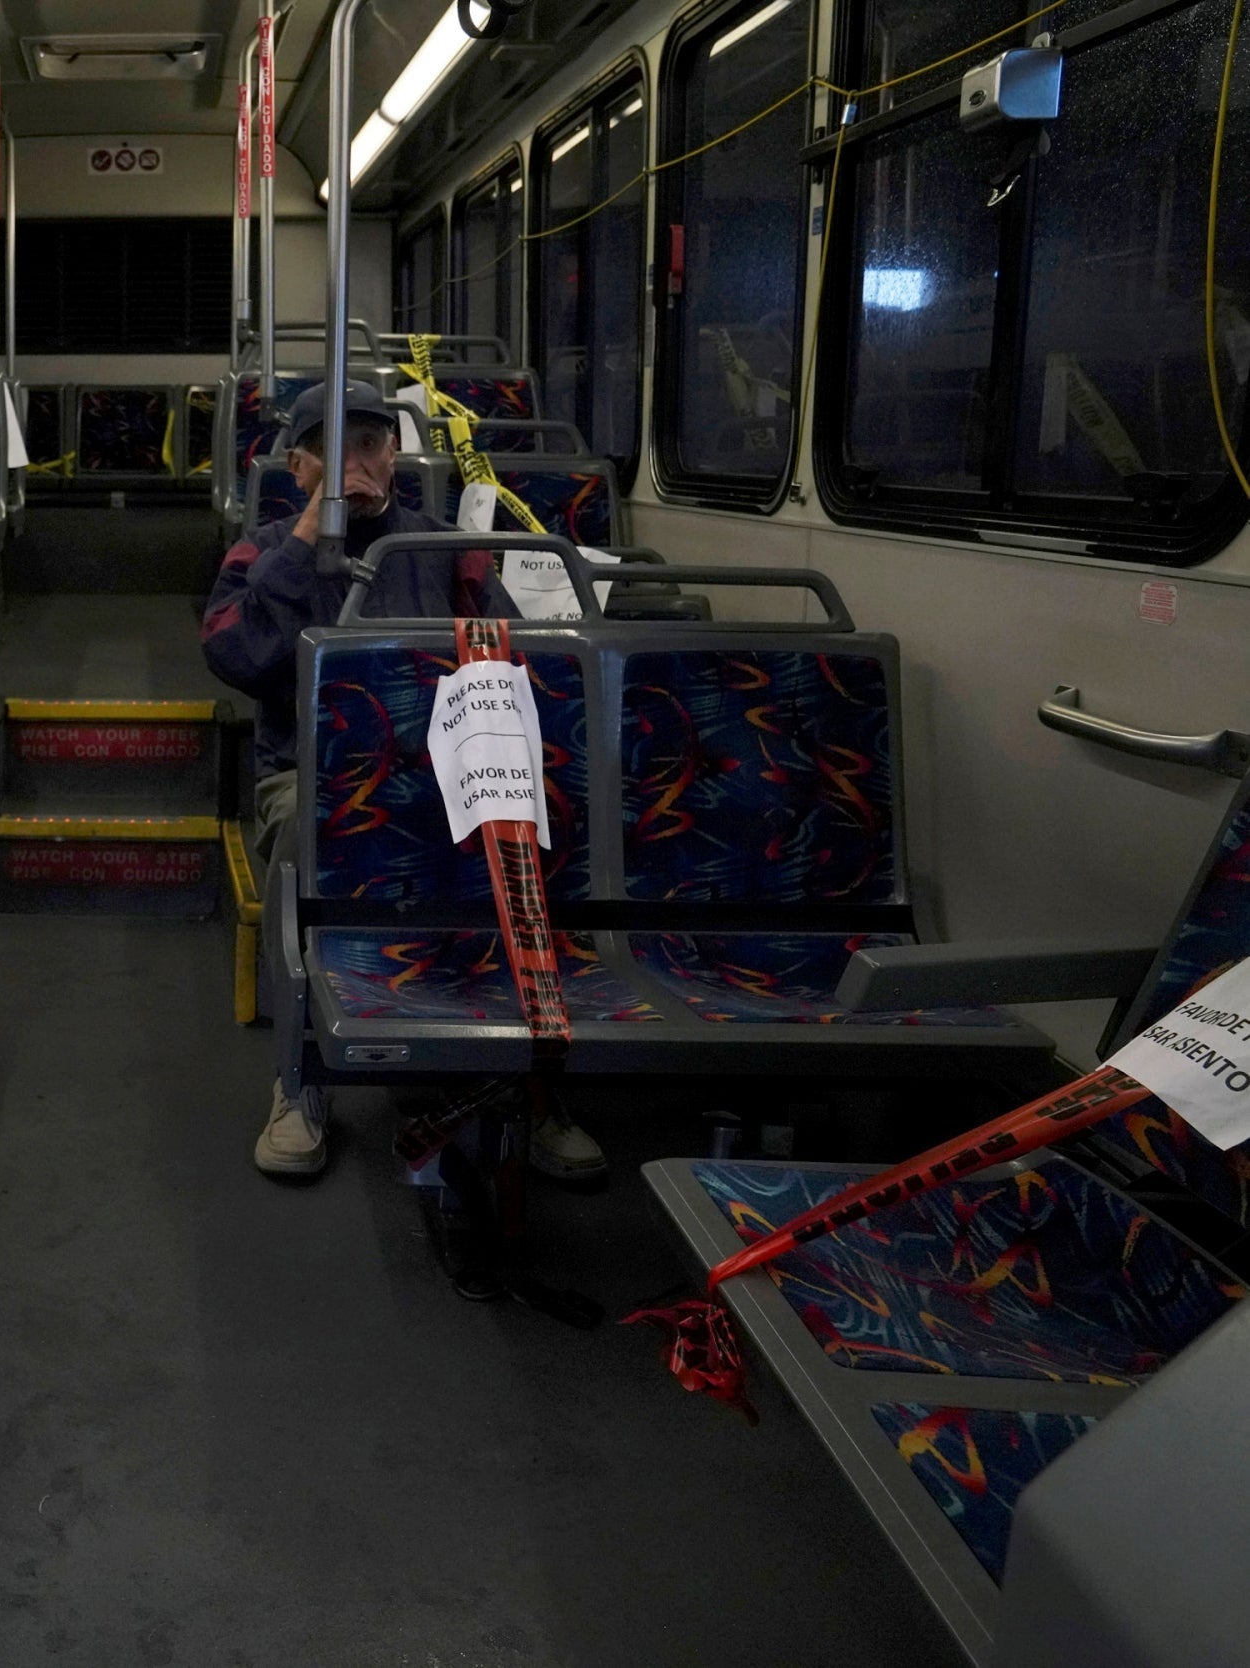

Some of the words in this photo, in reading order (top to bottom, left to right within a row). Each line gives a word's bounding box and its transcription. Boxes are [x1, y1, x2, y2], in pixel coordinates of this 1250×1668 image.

[262, 107, 272, 172] CUIDADO
[238, 159, 247, 214] CUIDADO
[520, 560, 544, 570] NOT
[548, 561, 565, 570] US
[447, 679, 494, 707] PLEASE
[442, 706, 467, 732] NOT
[471, 700, 499, 711] USE
[21, 728, 79, 741] WATCH
[96, 728, 141, 741] YOUR
[157, 728, 199, 741] STEP
[74, 744, 110, 758] CON
[125, 744, 200, 757] CUIDADO
[460, 768, 508, 789] FAVOR
[511, 768, 531, 780] DE
[464, 789, 501, 810] USAR
[12, 849, 74, 863] WATCH
[90, 850, 140, 864] YOUR
[156, 850, 201, 865] STEP
[123, 866, 202, 881] CUIDADO
[1174, 1002, 1227, 1025] FAVOR
